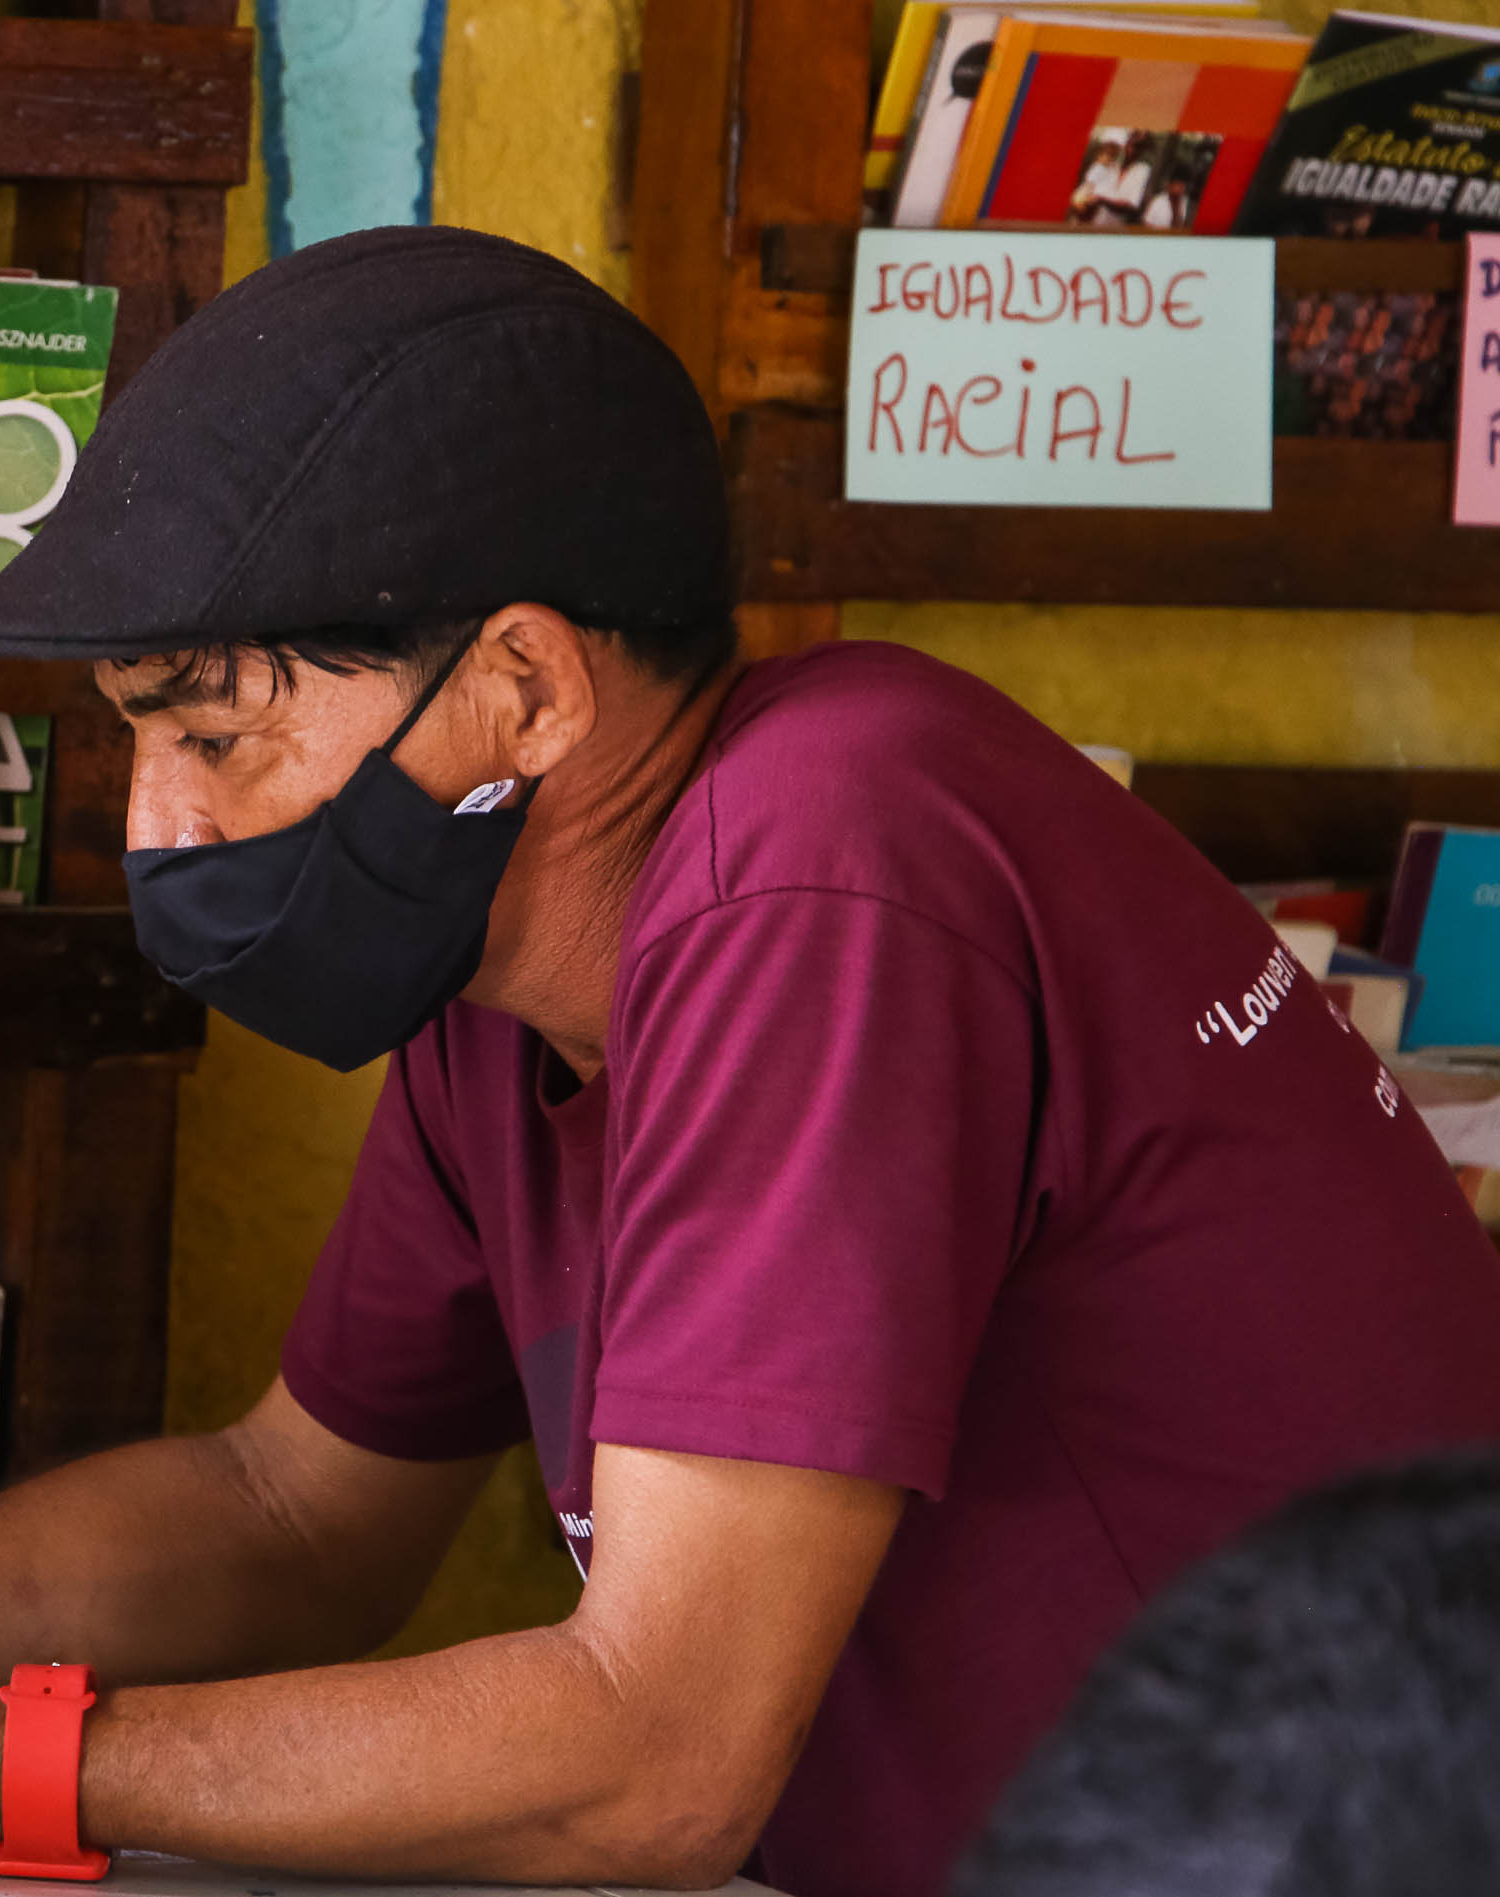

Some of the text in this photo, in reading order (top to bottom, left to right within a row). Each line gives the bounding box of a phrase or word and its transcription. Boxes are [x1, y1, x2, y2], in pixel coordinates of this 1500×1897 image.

[1282, 156, 1457, 212] IGUALDADE
[868, 253, 1207, 329] IGUALDADE
[868, 352, 1176, 465] RACIAL
